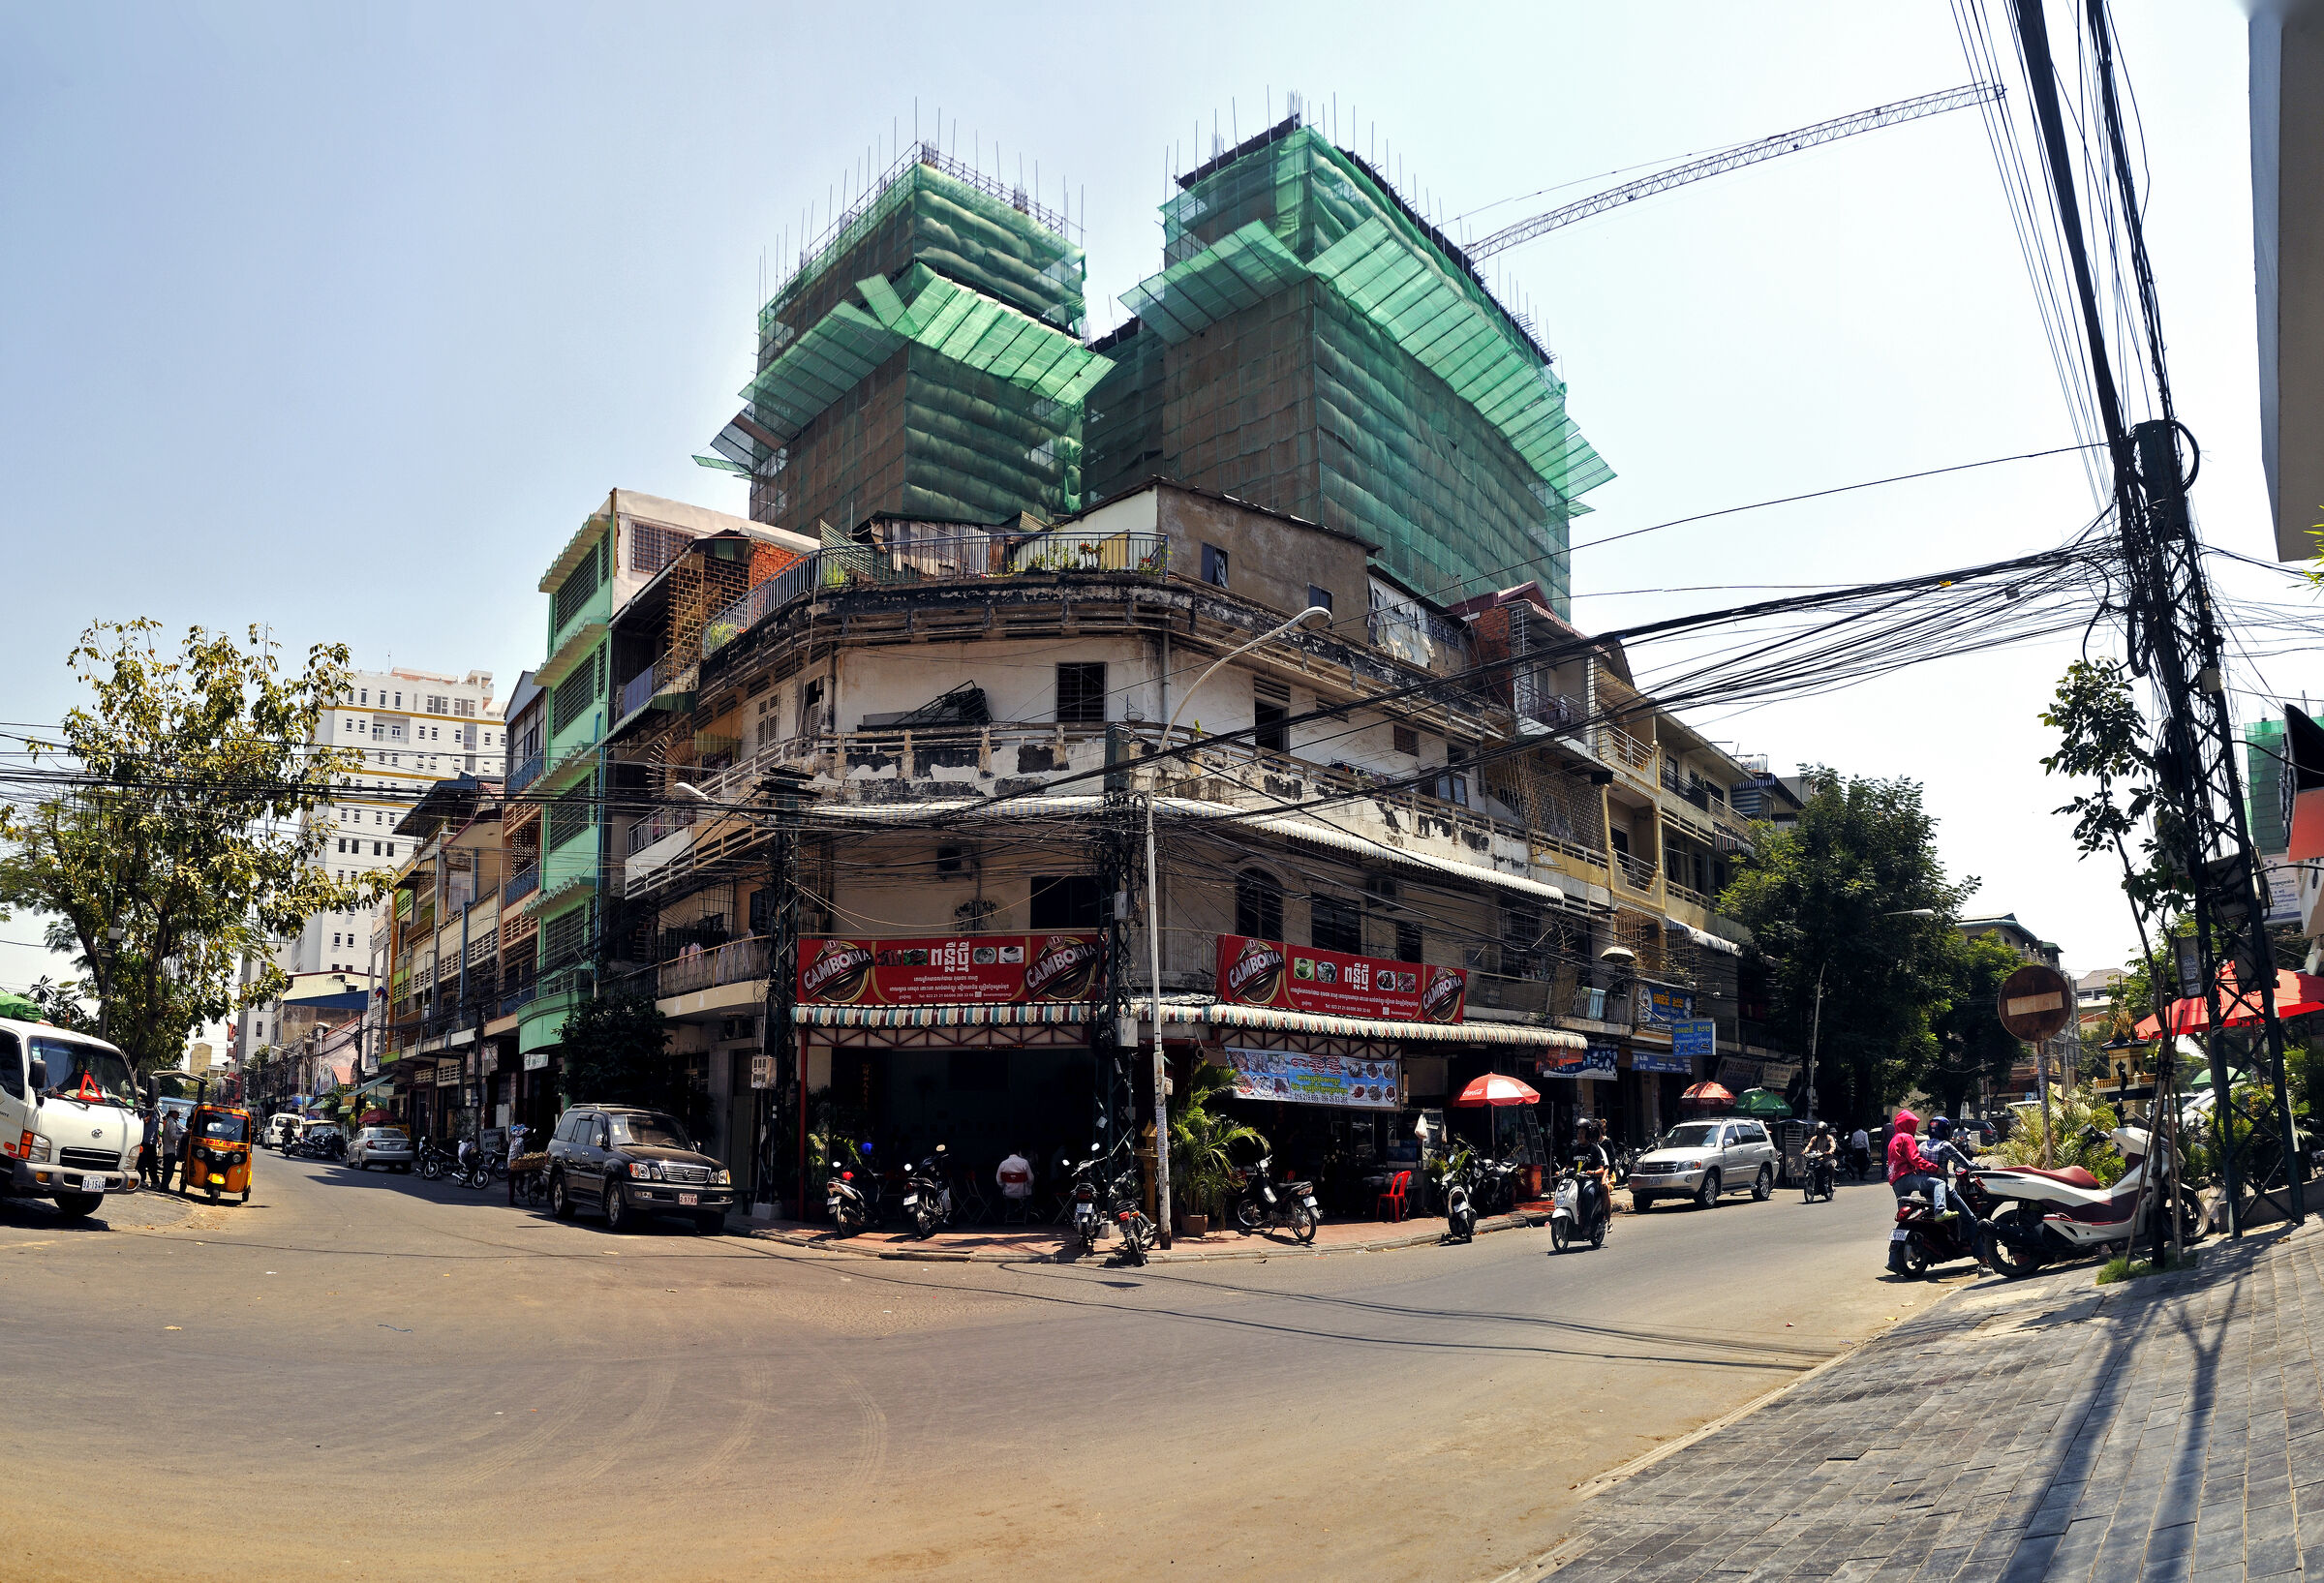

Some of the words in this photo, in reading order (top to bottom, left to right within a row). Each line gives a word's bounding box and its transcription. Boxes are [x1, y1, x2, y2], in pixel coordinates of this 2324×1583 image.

[804, 950, 871, 989] CAMBODIA
[1025, 945, 1097, 988] CAMBODIA
[1230, 952, 1282, 989] CAMBODIA
[1422, 977, 1463, 1009] CAMBODIA
[205, 1138, 220, 1146] Tok
[222, 1140, 236, 1148] Tok
